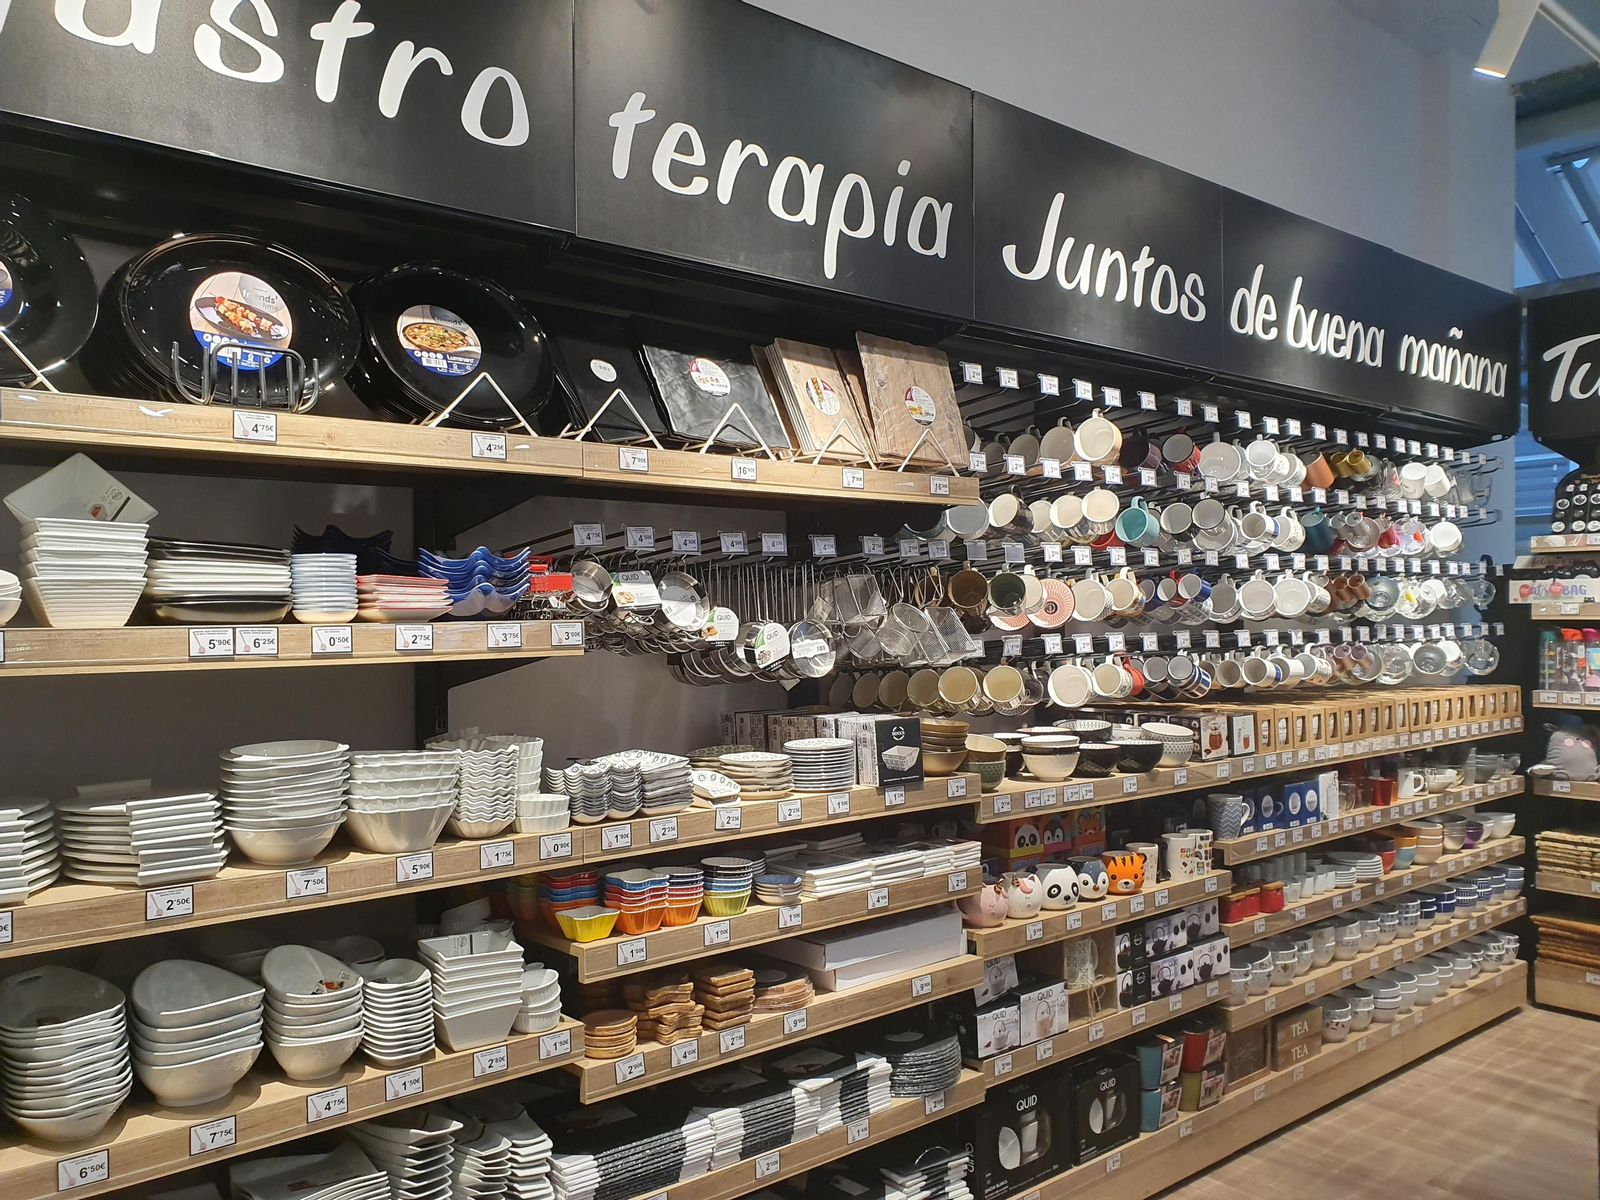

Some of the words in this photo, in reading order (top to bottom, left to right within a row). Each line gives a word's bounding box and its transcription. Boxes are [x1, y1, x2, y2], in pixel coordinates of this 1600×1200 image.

[0, 0, 530, 148] astro
[608, 91, 953, 280] terapia
[1002, 192, 1207, 322] Juntos
[1230, 263, 1278, 341] de
[1287, 276, 1385, 367] buena
[1400, 327, 1508, 398] mañana
[252, 423, 274, 434] 4'75€
[486, 443, 504, 453] 4'25€
[586, 532, 601, 541] 4'75€
[621, 573, 639, 581] QUID
[1563, 584, 1587, 596] BAG
[329, 636, 349, 646] 0'50€
[411, 634, 431, 644] 2'75€
[501, 633, 519, 642] 3'75€
[564, 631, 580, 641] 3'00€
[766, 630, 779, 641] QUID
[208, 638, 231, 649] 5'90€
[253, 638, 275, 648] 6'25€
[553, 842, 570, 852] 0'90€
[494, 851, 512, 861] 1'75€
[412, 863, 430, 874] 5'90€
[303, 878, 325, 890] 7'50€
[166, 897, 190, 911] 2'50€
[1037, 988, 1053, 1000] QUID
[992, 1010, 1006, 1021] QUID
[1290, 1020, 1309, 1037] TEA
[553, 1039, 569, 1051] 1'50€
[1290, 1044, 1309, 1061] TEA
[488, 1055, 505, 1068] 2'80€
[401, 1077, 420, 1091] 1'50€
[1099, 1077, 1116, 1091] QUID
[324, 1098, 345, 1112] 4'75€
[1016, 1094, 1038, 1112] QUID
[209, 1128, 233, 1144] 7'75€
[79, 1162, 106, 1179] 6'50€
